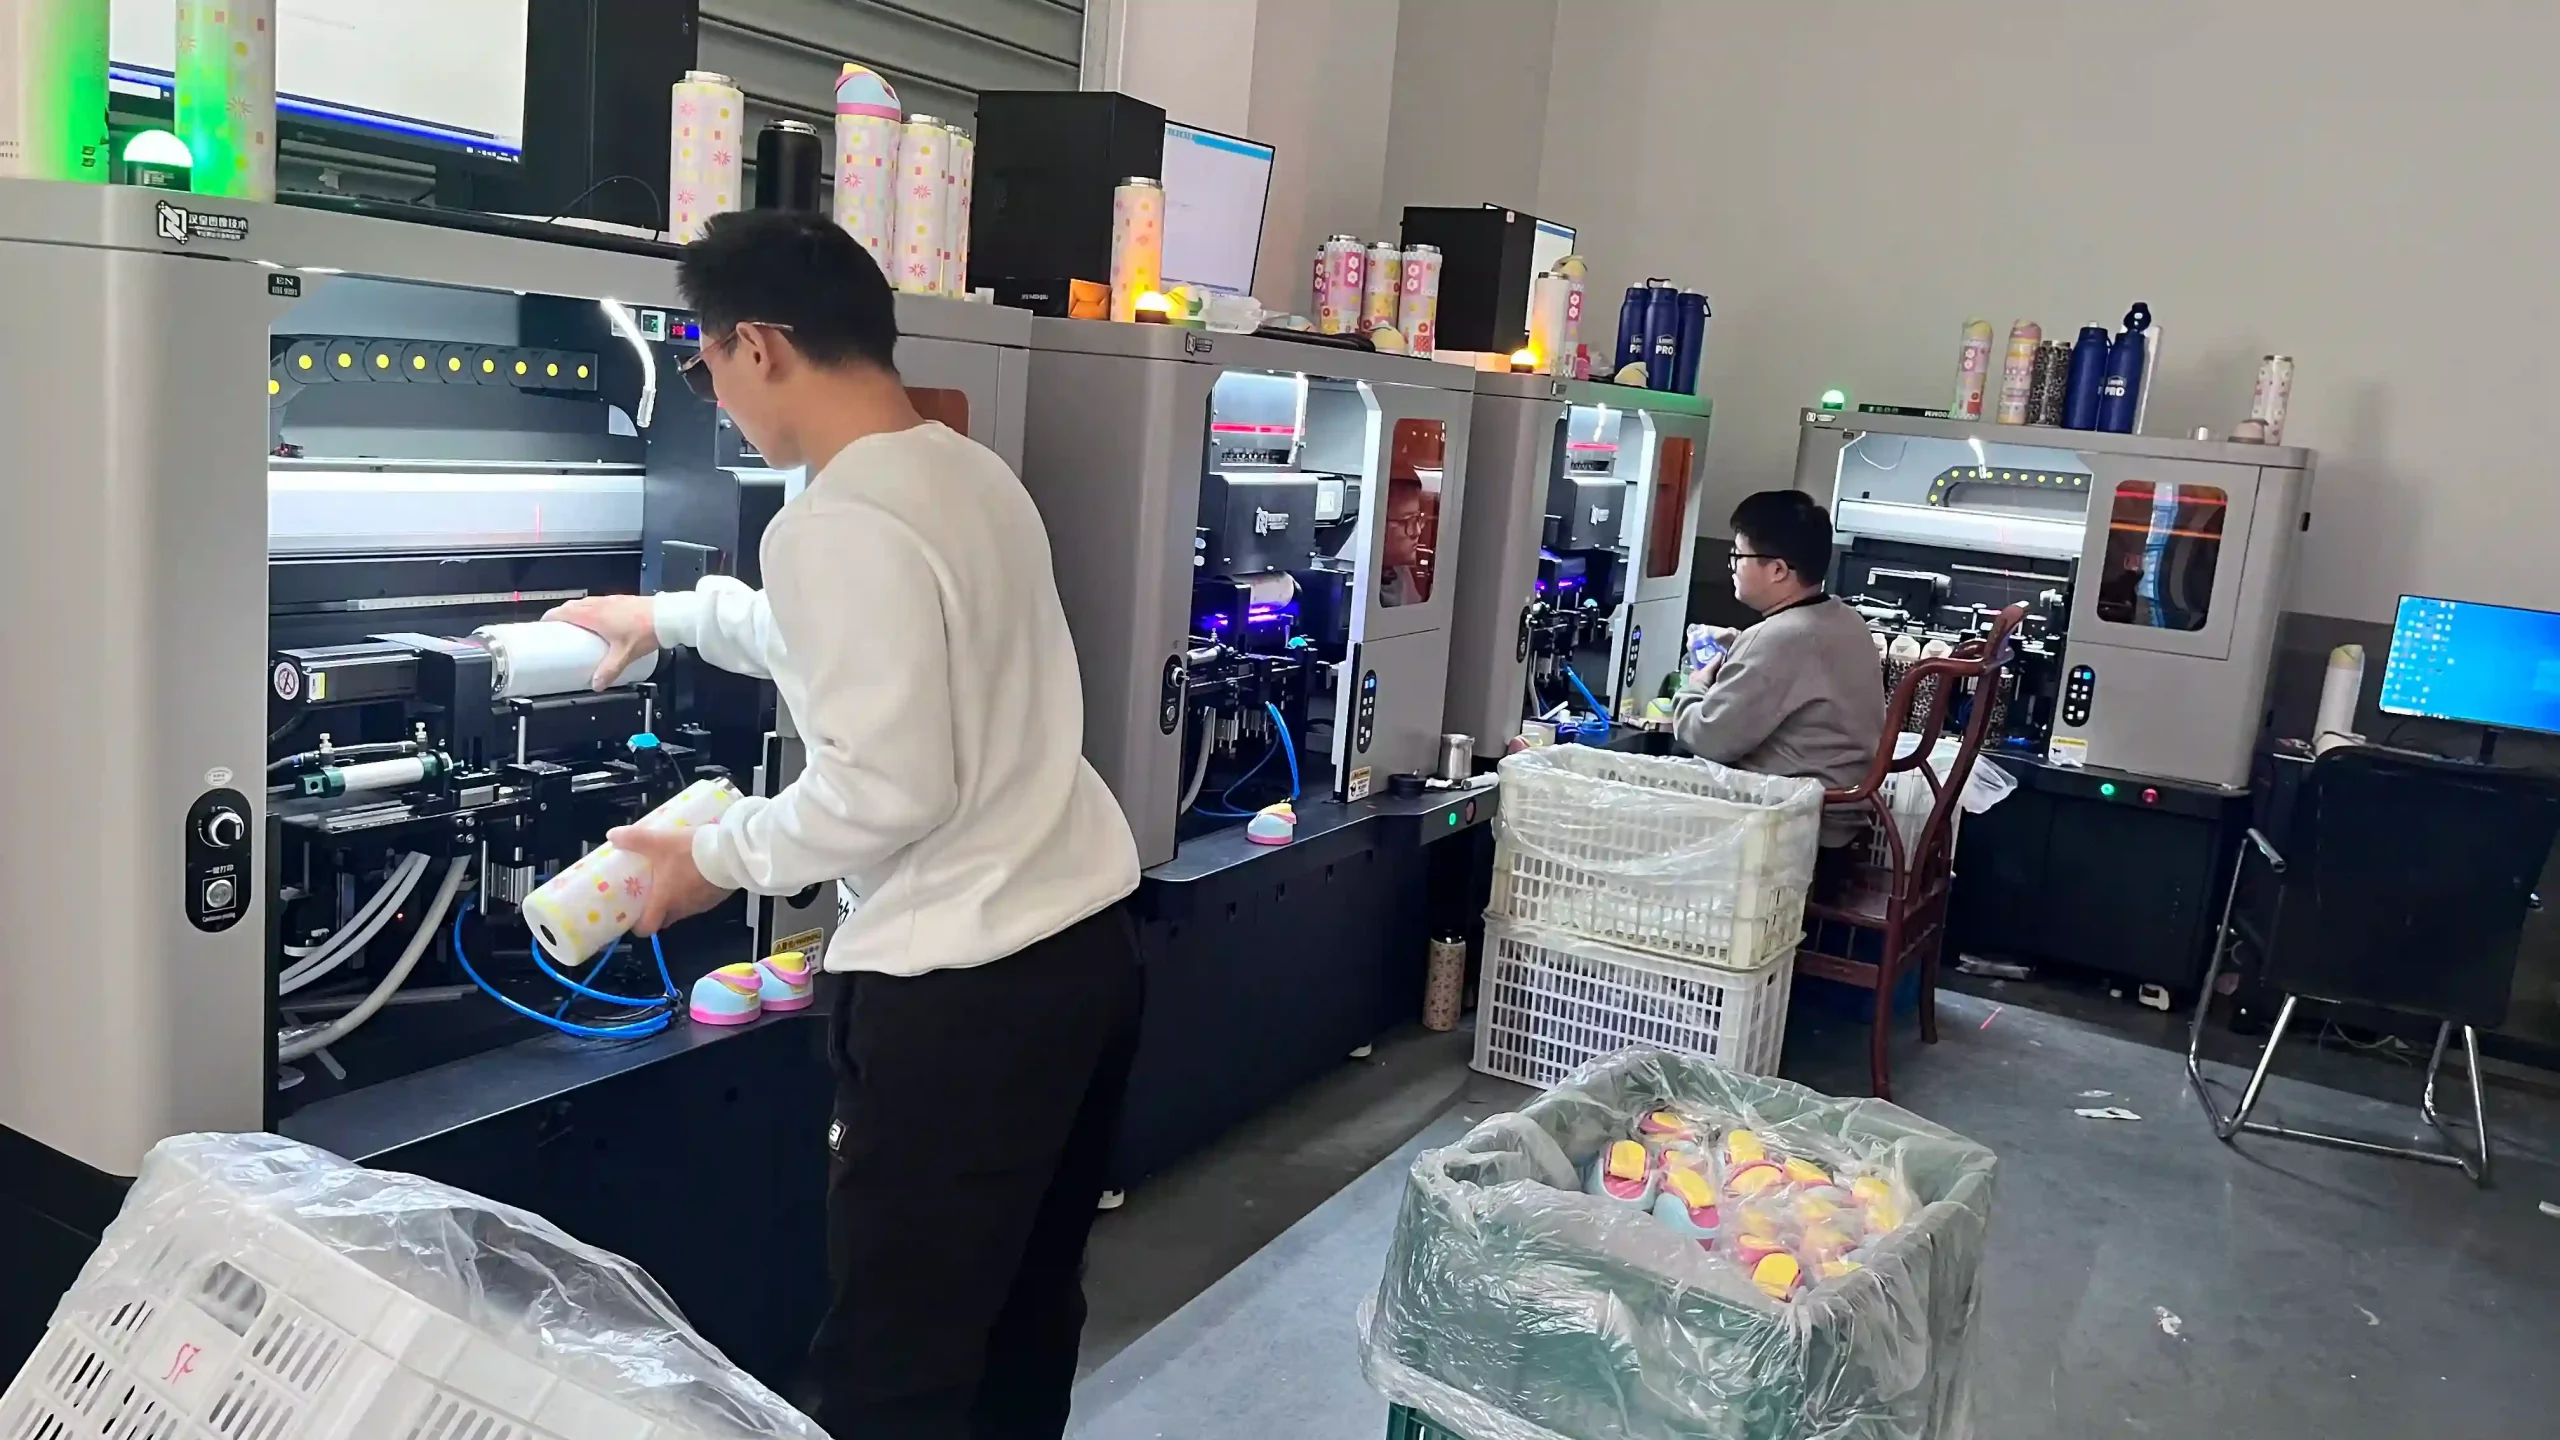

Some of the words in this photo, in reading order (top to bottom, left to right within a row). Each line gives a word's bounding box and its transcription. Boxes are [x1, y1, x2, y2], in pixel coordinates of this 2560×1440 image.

[276, 276, 294, 286] EN
[1629, 344, 1642, 354] PR
[1655, 344, 1674, 355] PRO
[2104, 386, 2125, 397] PRO
